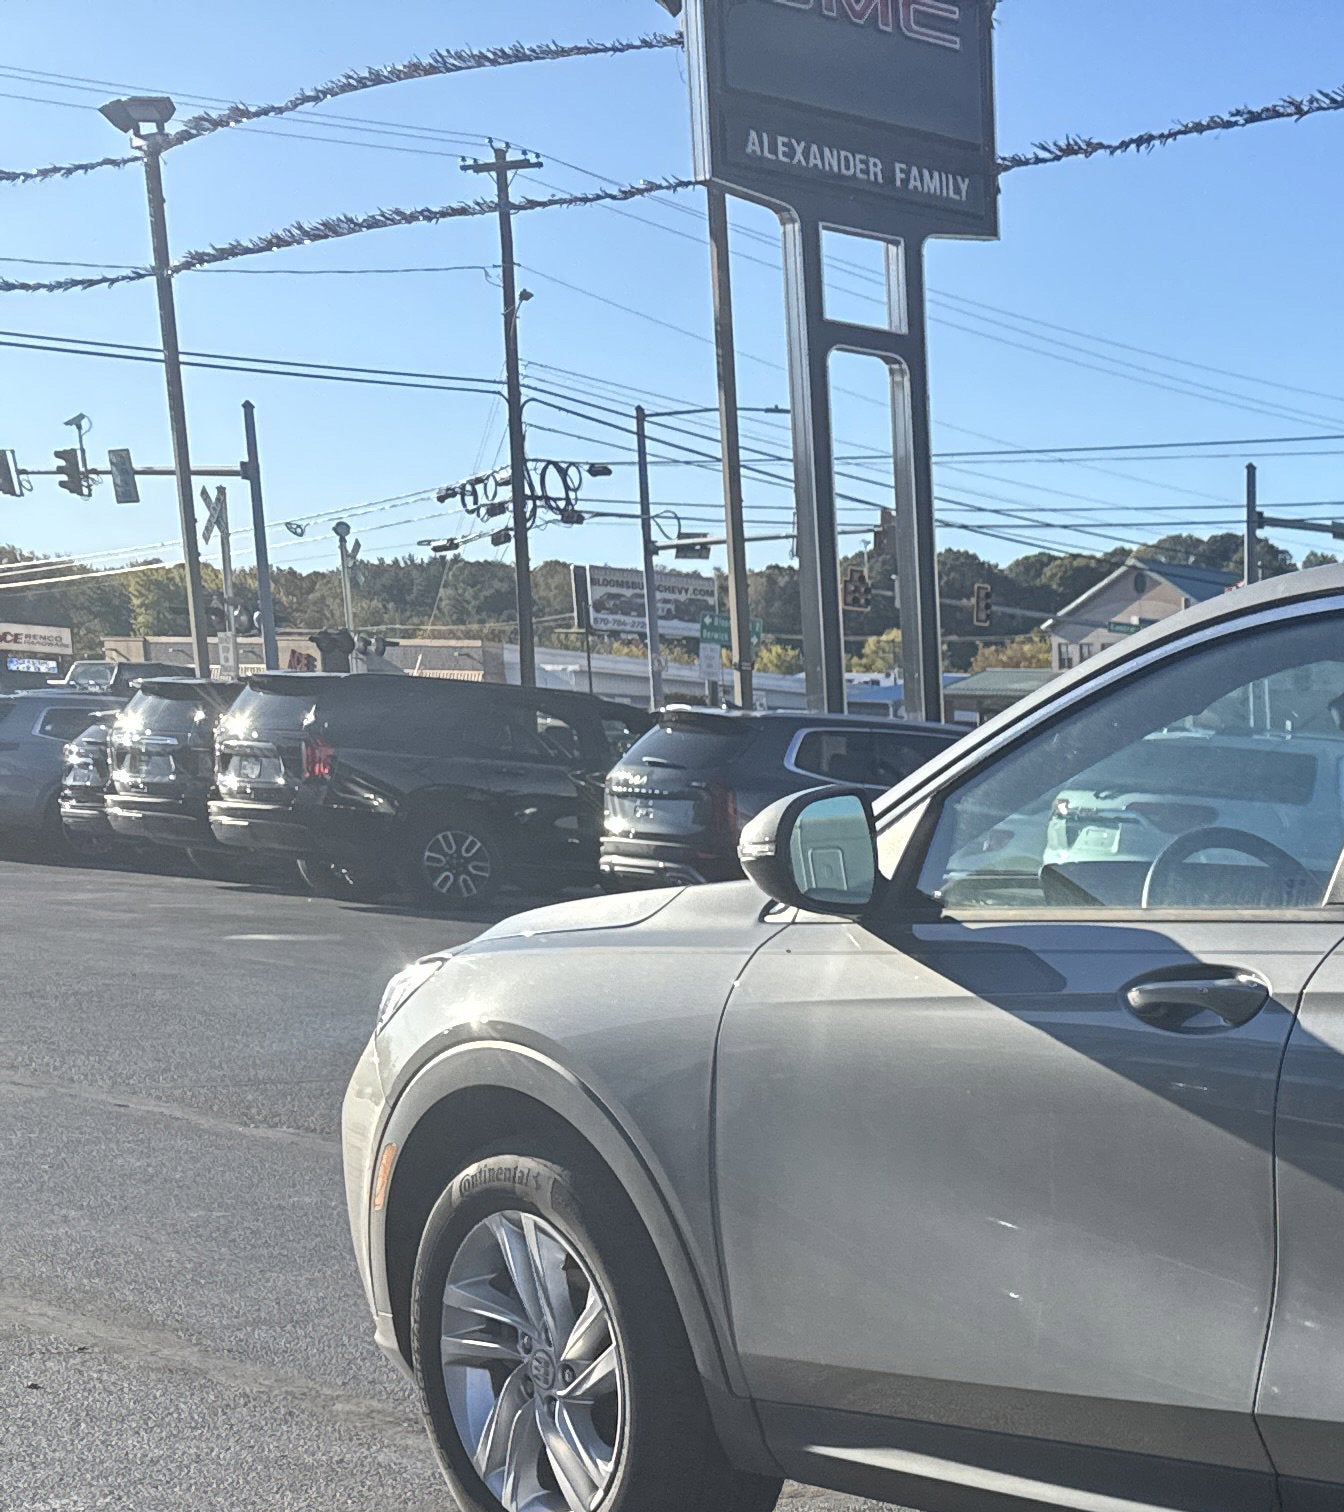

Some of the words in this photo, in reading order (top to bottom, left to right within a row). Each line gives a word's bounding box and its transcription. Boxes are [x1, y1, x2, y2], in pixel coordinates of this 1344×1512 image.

[745, 129, 884, 185] ALEXANDER
[894, 162, 970, 202] FAMILY
[460, 1164, 531, 1195] Continental
